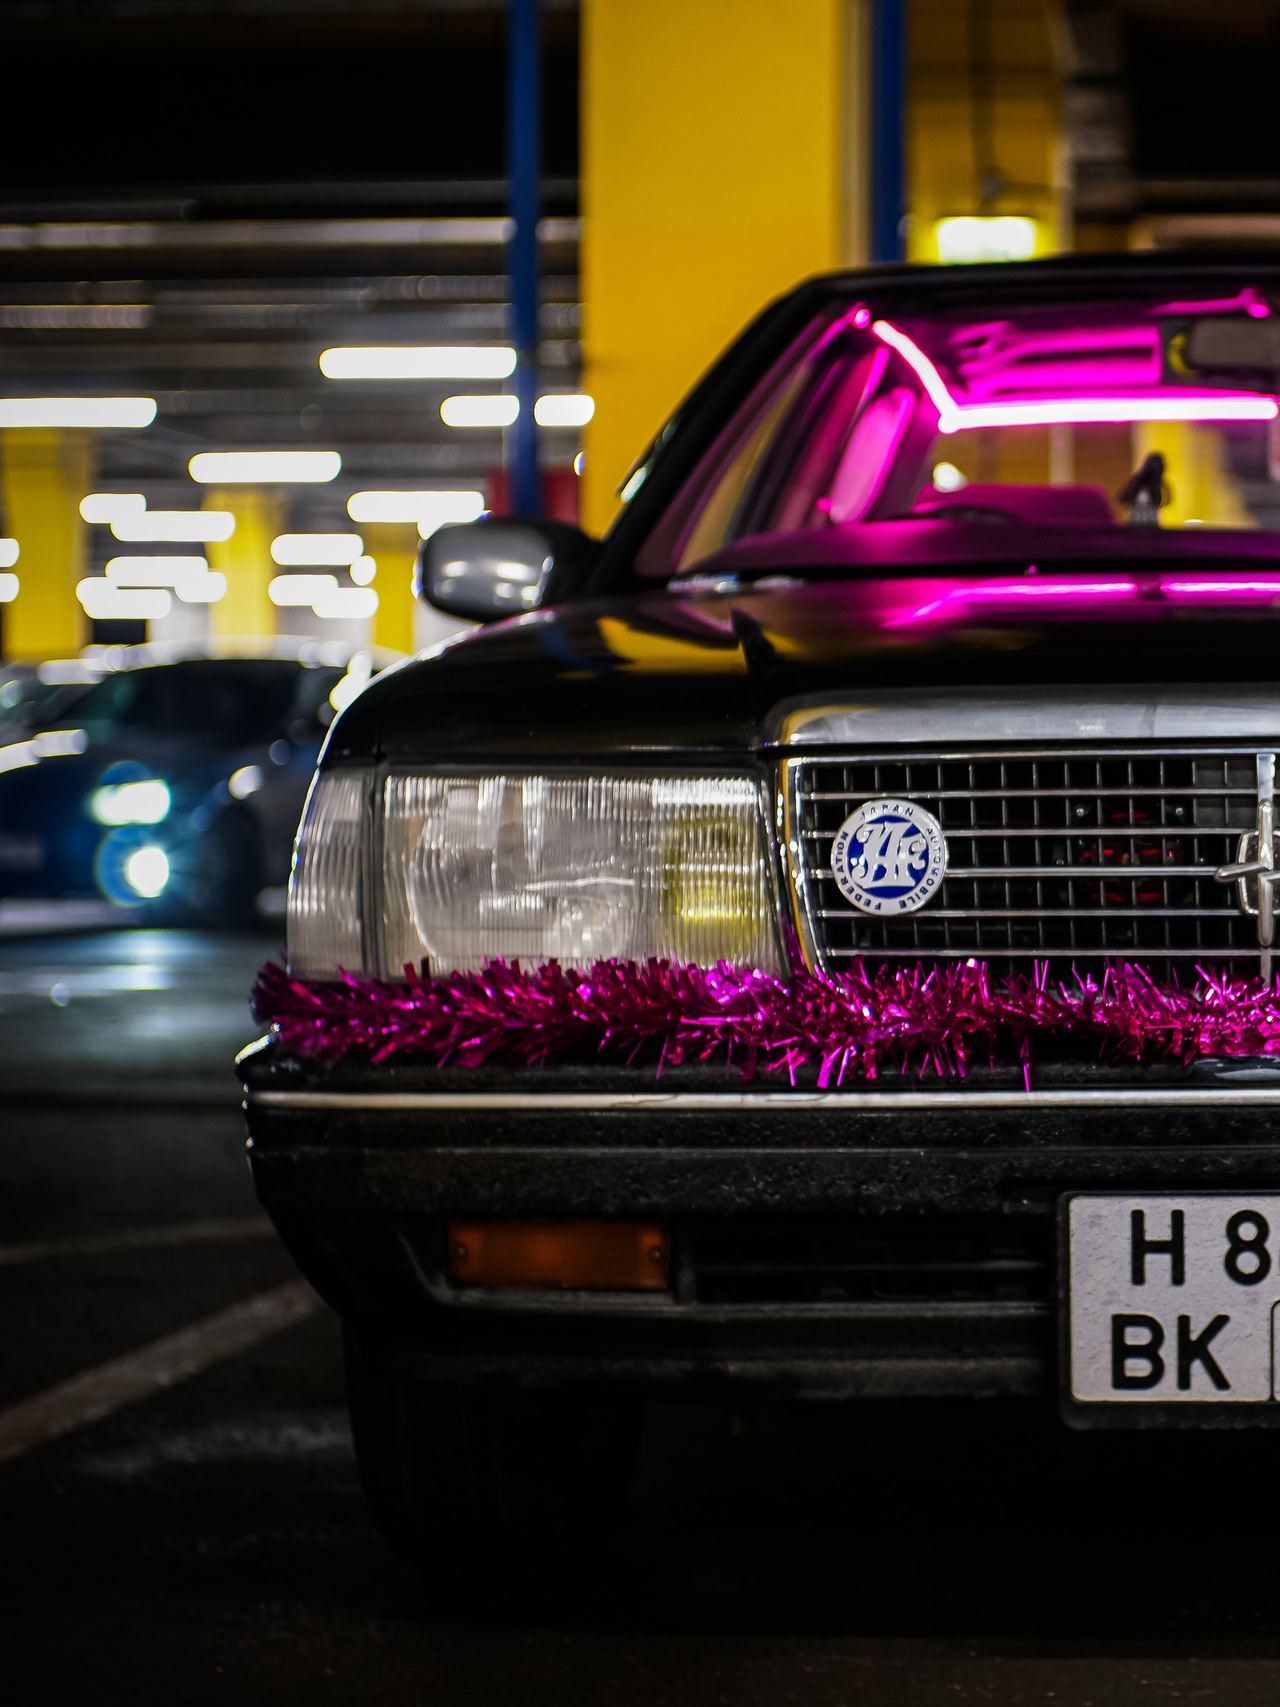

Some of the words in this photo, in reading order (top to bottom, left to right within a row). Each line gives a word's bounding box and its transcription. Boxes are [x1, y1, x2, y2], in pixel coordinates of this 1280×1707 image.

[860, 804, 914, 820] JAPAN
[834, 831, 882, 911] FEDERATION
[898, 827, 941, 909] AUTOMOBILE
[1130, 1209, 1186, 1286] H
[1110, 1313, 1231, 1391] BK
